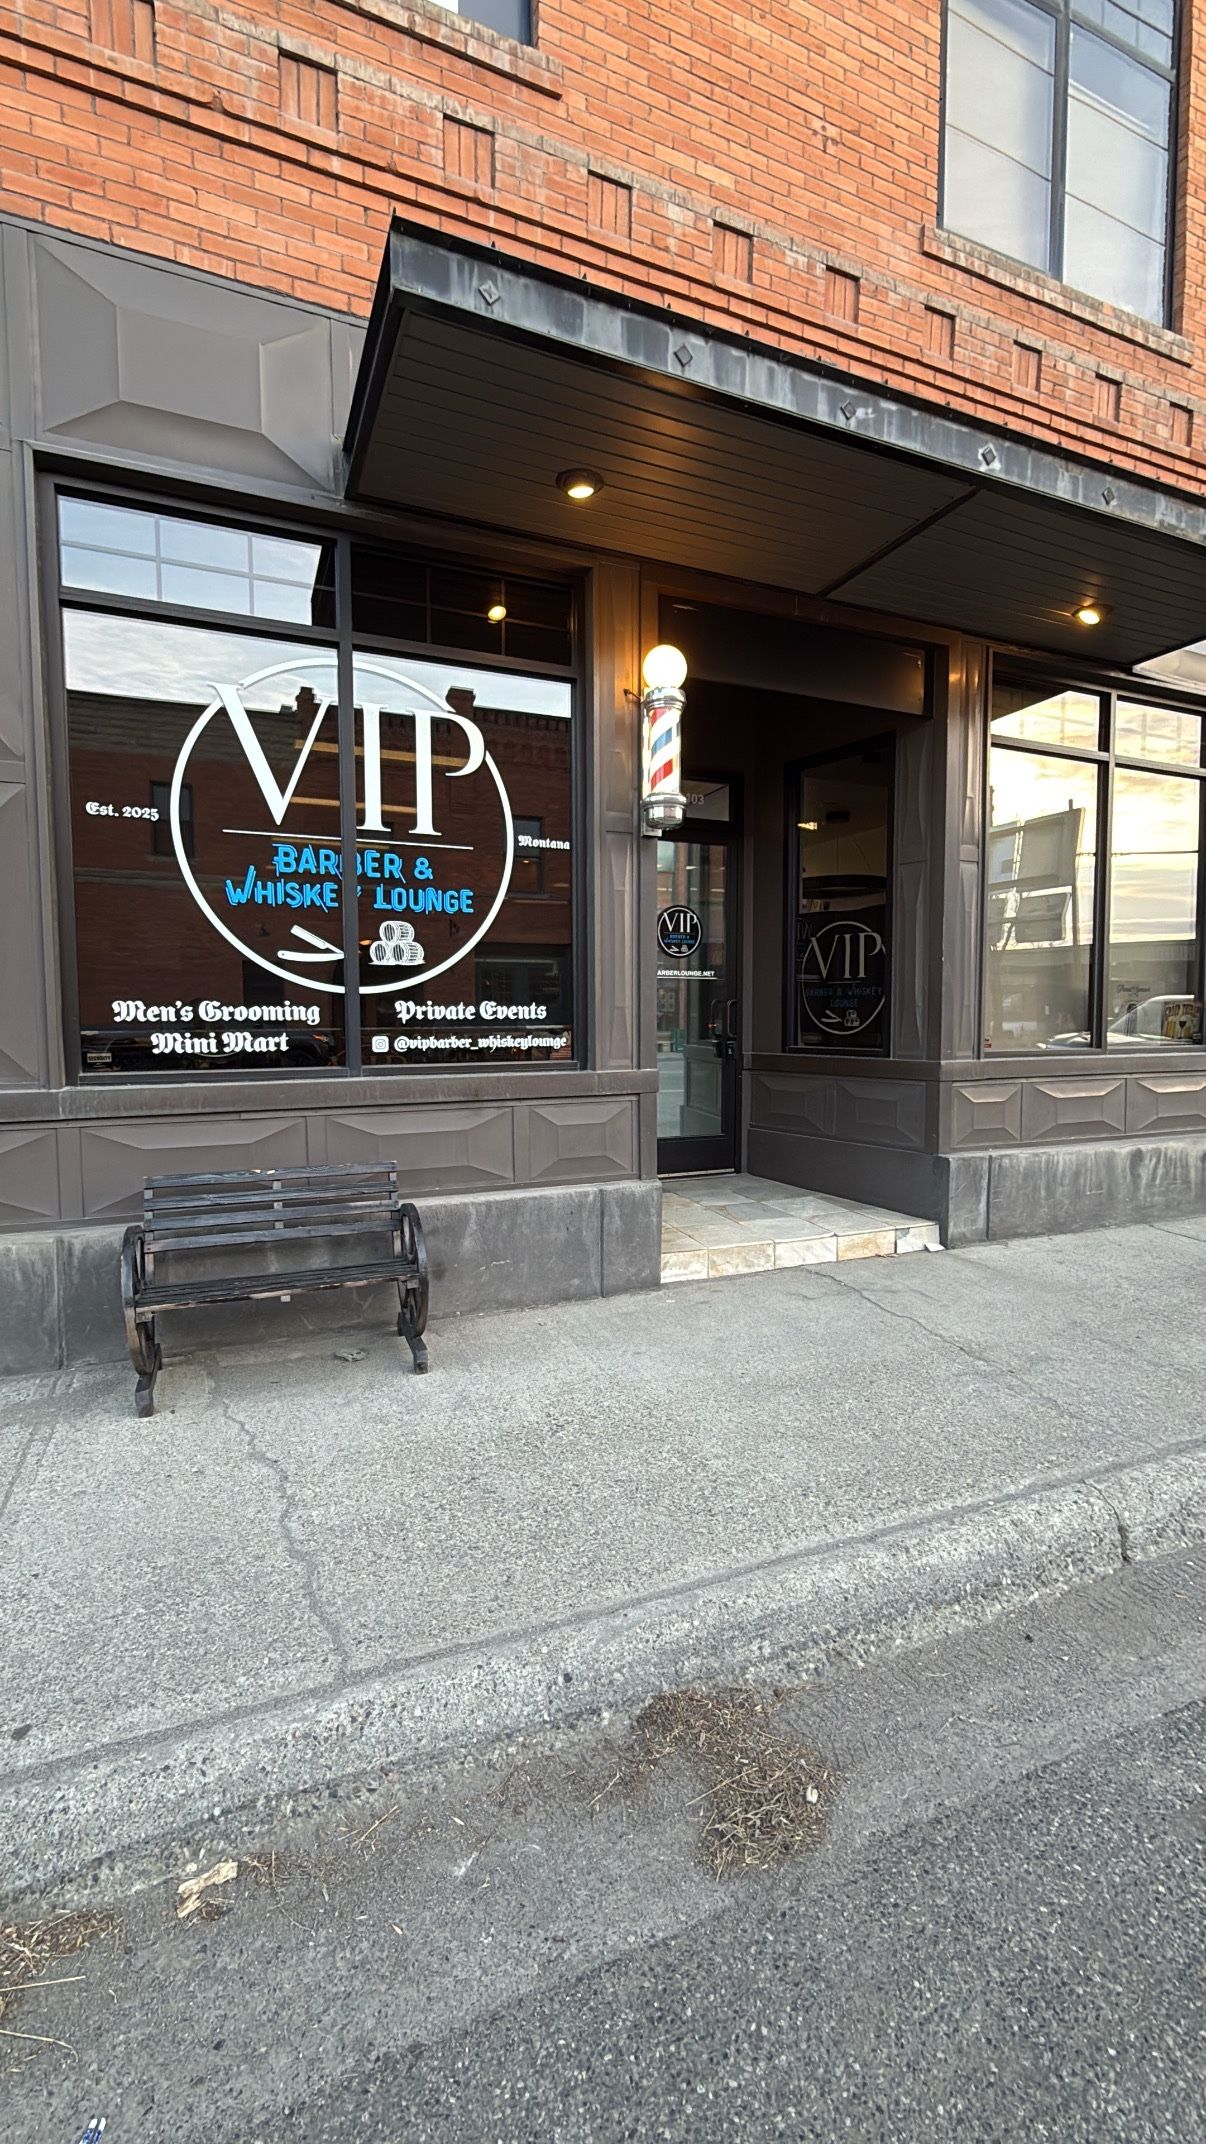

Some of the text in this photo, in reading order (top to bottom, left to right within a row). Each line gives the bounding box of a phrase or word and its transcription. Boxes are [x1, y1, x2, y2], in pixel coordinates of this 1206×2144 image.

[208, 681, 486, 836] VIP
[85, 801, 160, 821] Est. 2025
[517, 835, 571, 850] Montana
[413, 857, 434, 880] &
[225, 865, 474, 914] WHISKE LOUNGE
[663, 912, 697, 932] VIP
[810, 932, 882, 979] VIP
[111, 1000, 321, 1026] Men's Grooming
[394, 1000, 547, 1024] Private Events
[150, 1031, 290, 1054] Mini Mart
[393, 1033, 568, 1053] @vipbarber_whiskeylounge
